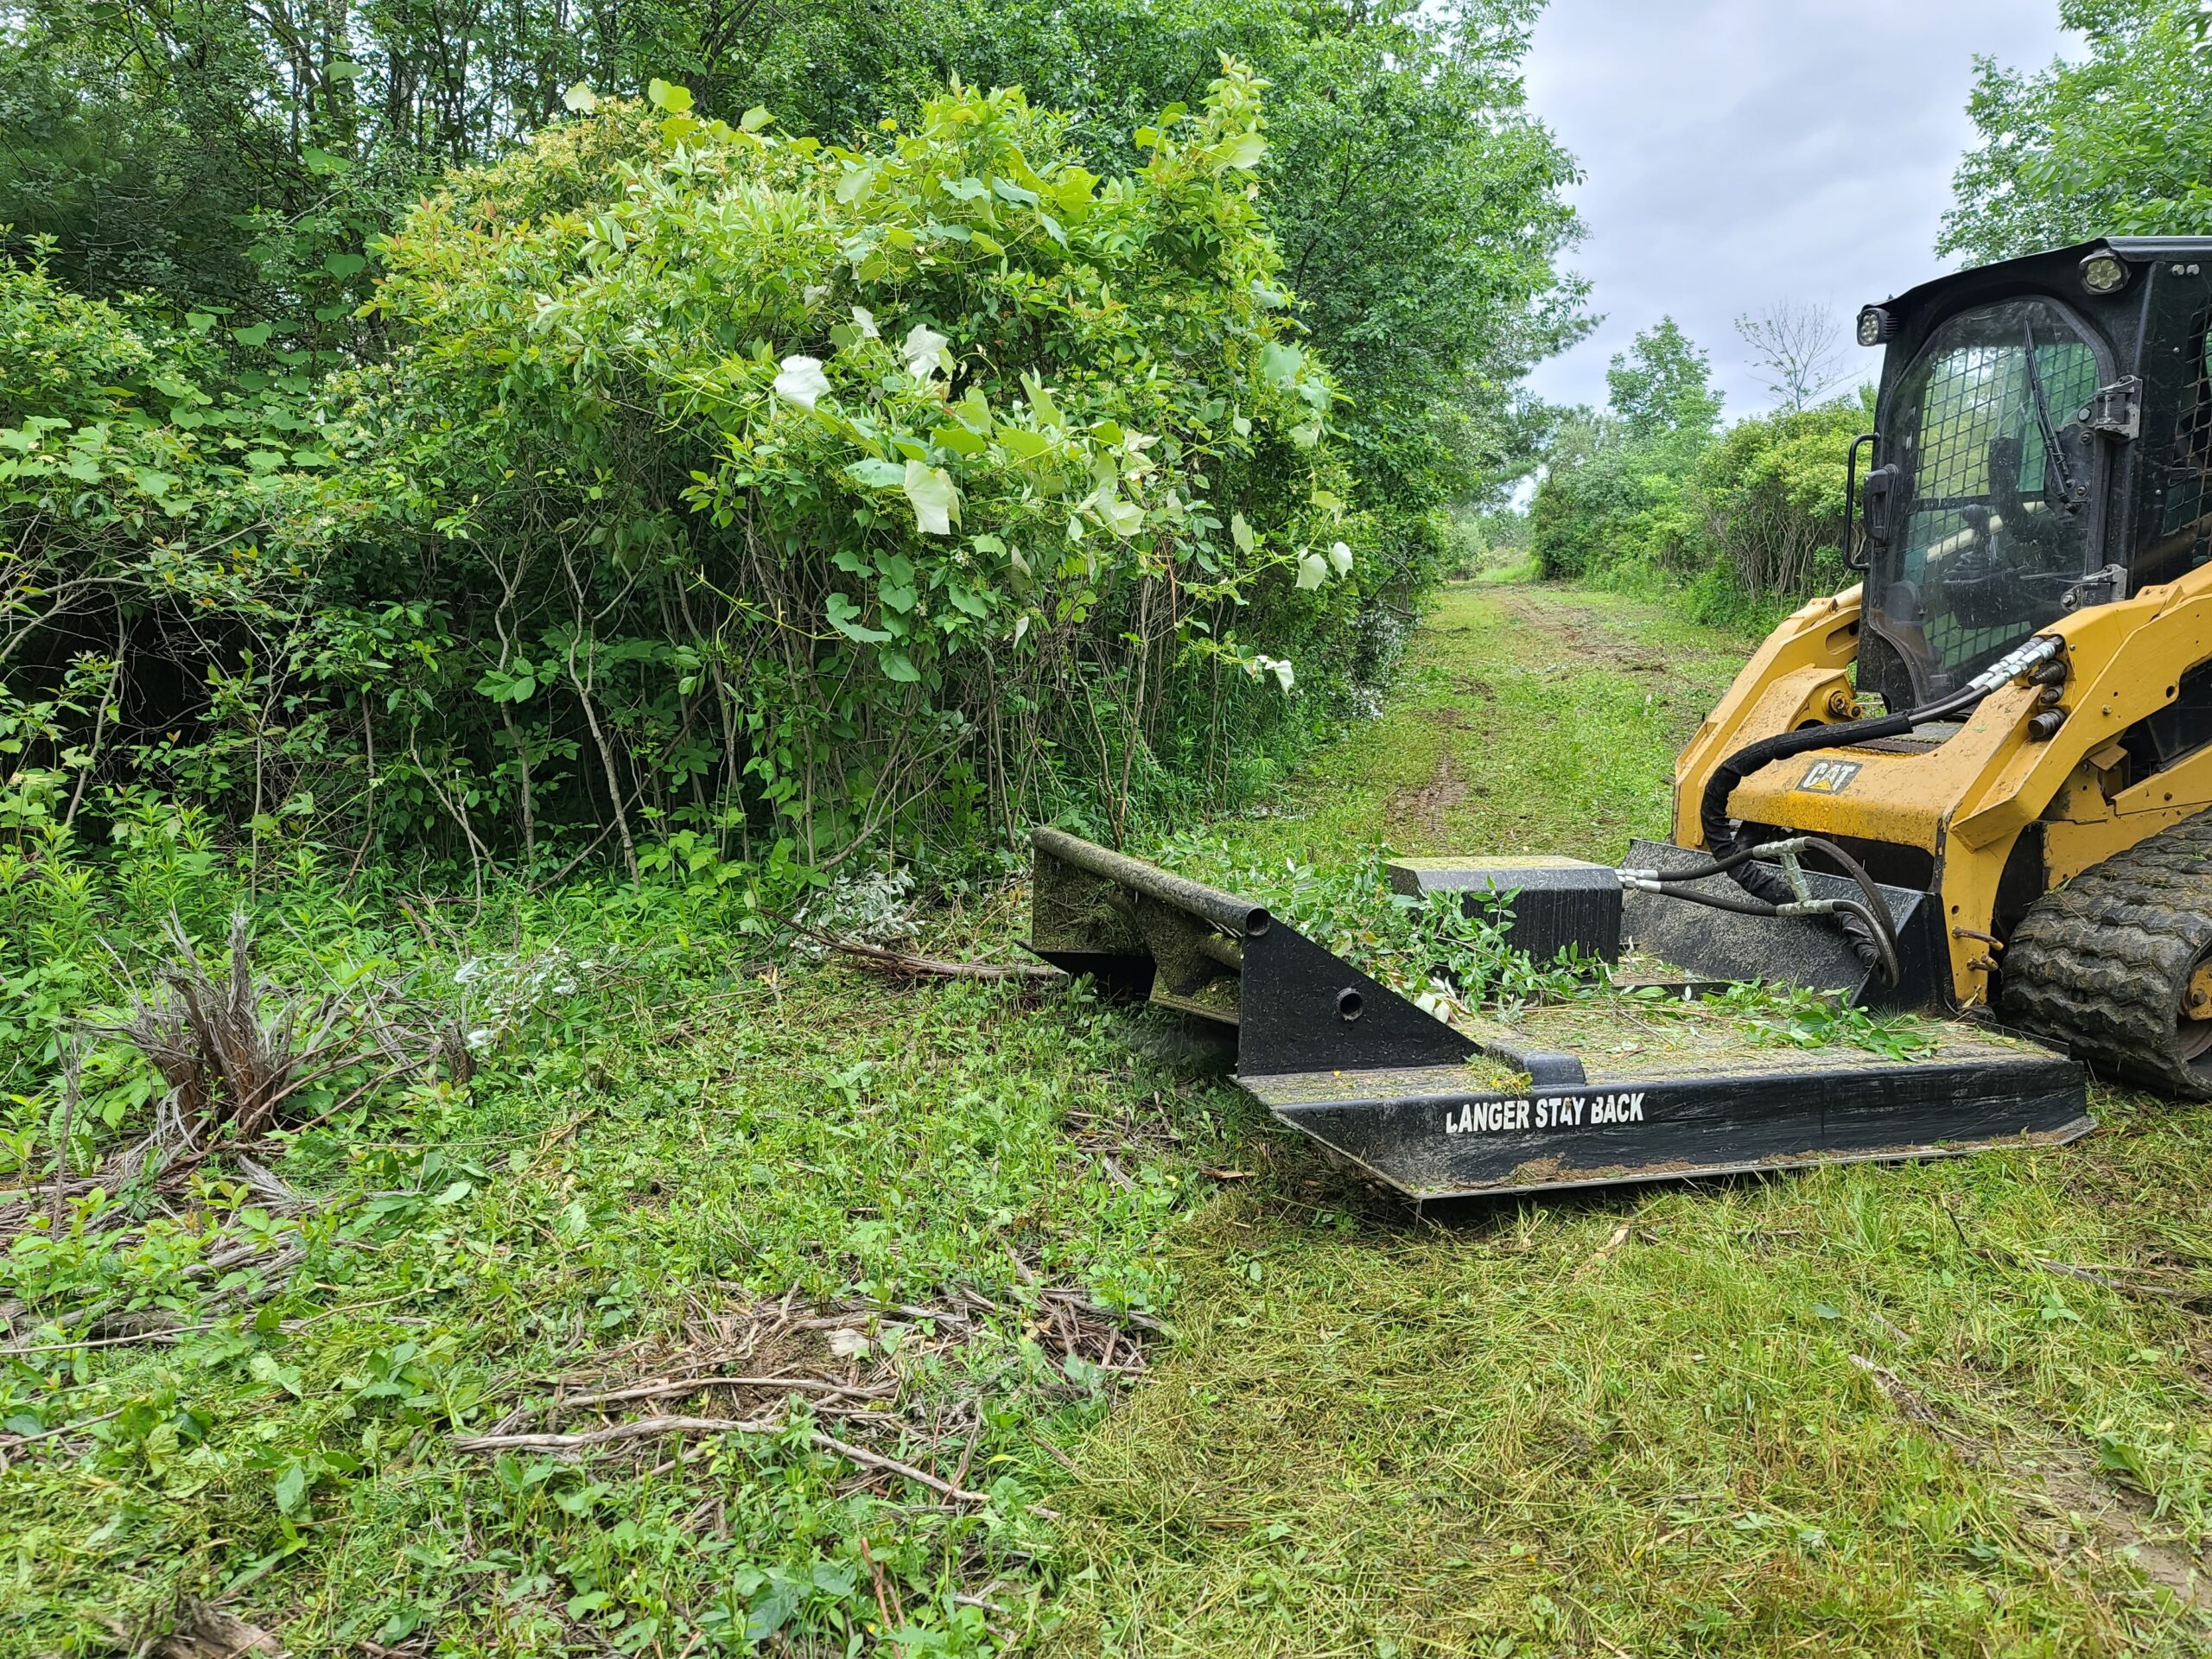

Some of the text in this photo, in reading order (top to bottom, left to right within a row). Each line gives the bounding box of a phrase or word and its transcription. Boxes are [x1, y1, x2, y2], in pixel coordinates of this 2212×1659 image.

[1802, 762, 1856, 791] CAT
[1535, 1097, 1586, 1128] STAY
[1591, 1092, 1645, 1124] BACK
